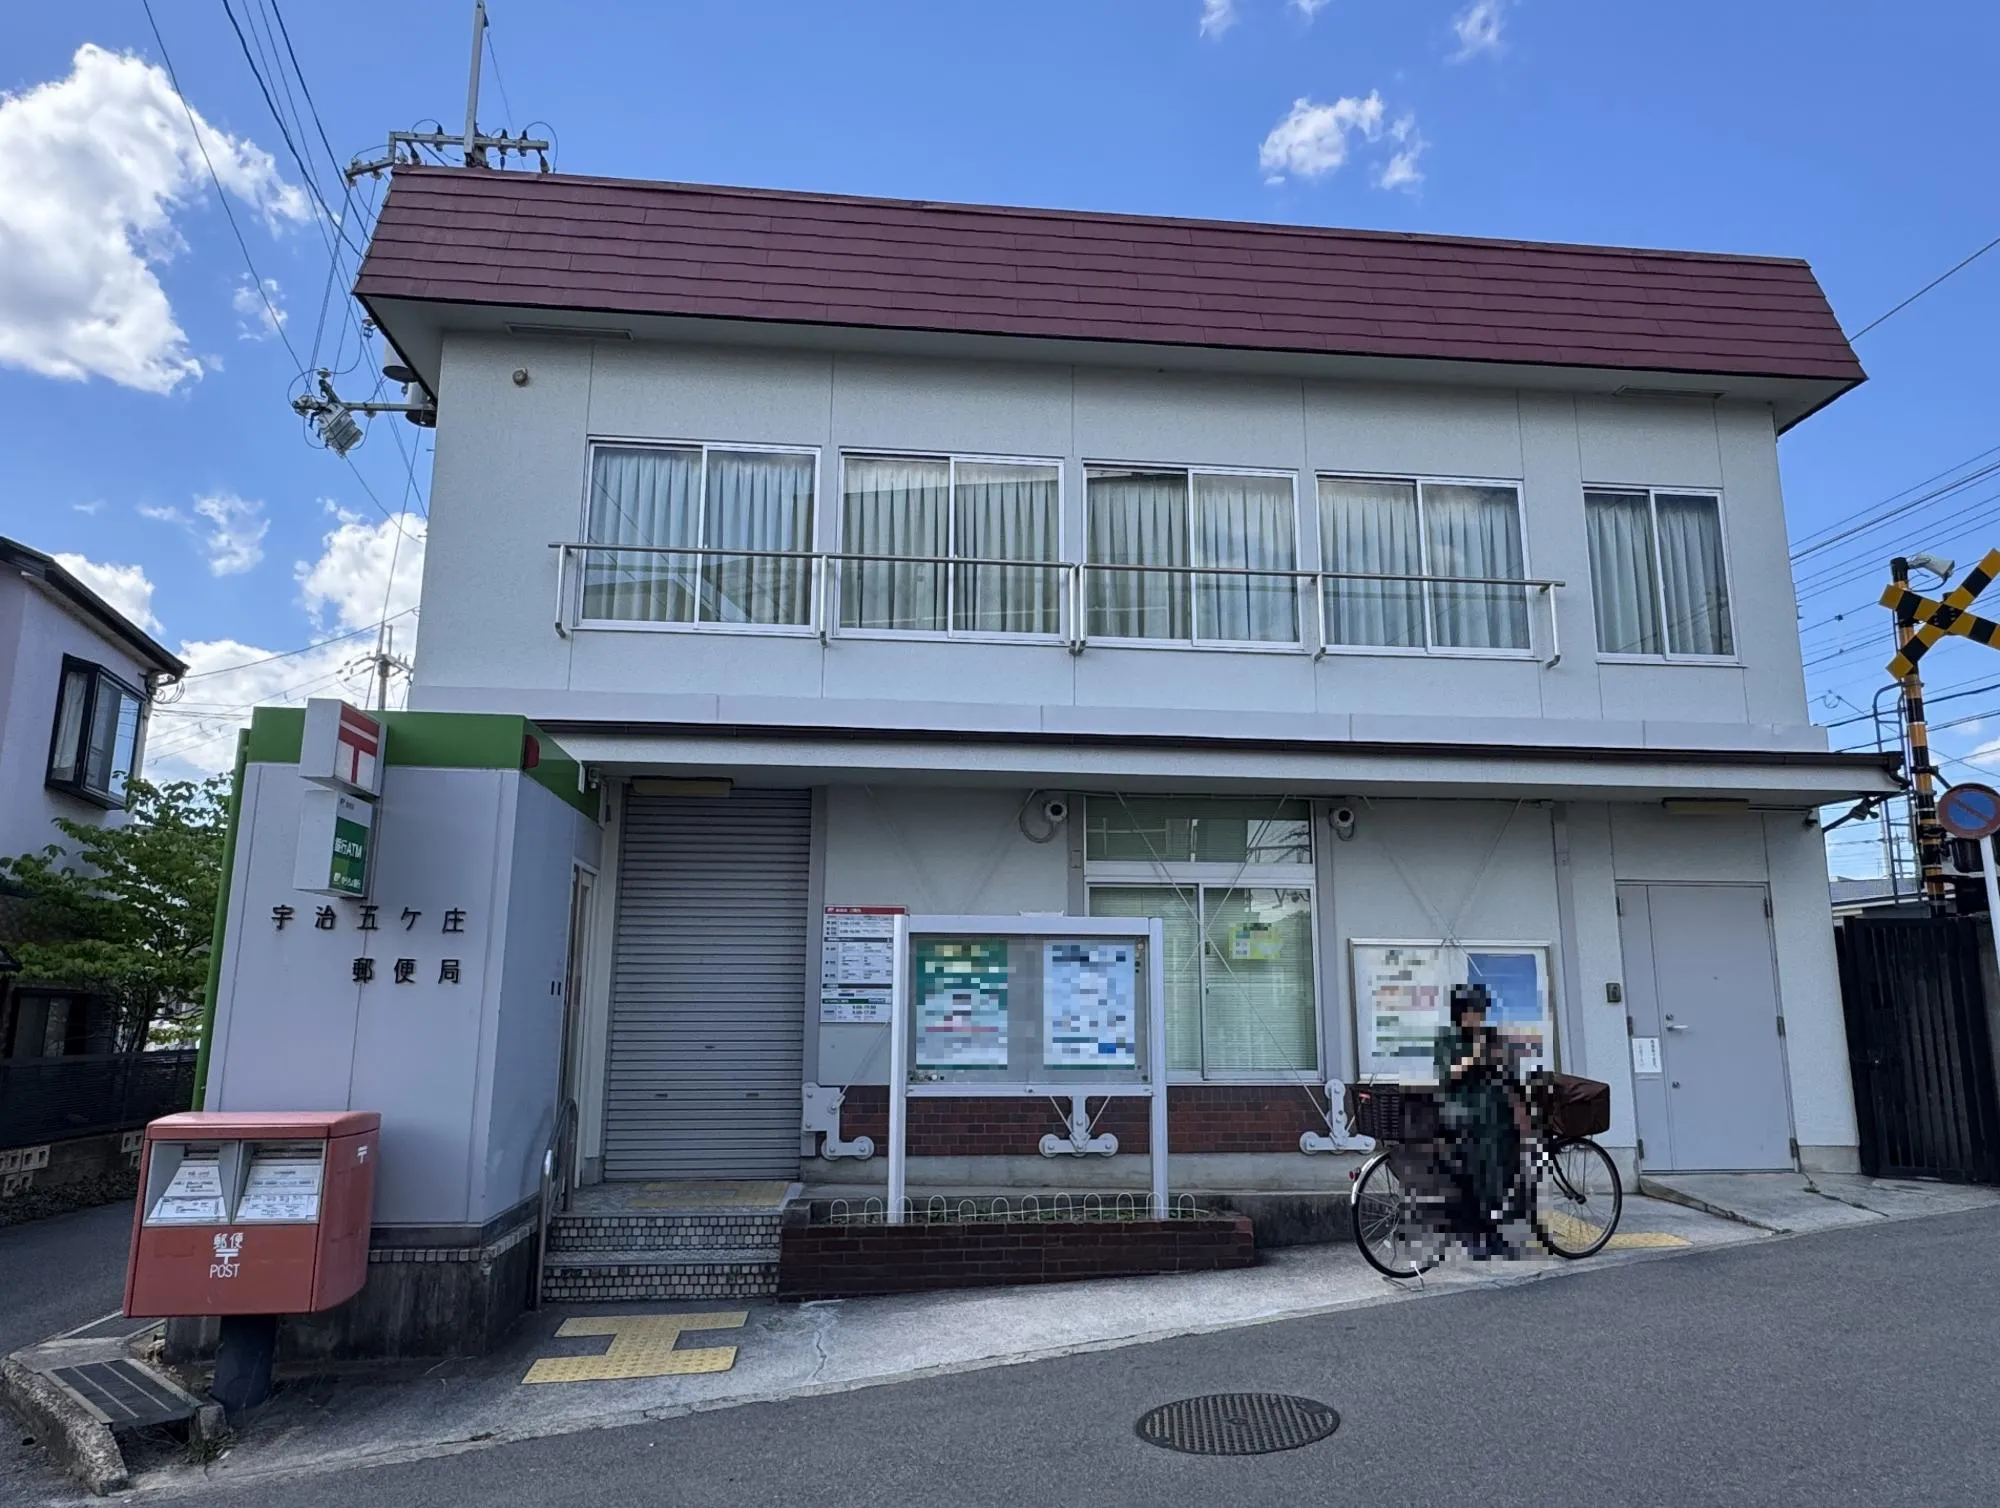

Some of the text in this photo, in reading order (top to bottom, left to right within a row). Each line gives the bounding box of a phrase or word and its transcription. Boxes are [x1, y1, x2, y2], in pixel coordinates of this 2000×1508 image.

[352, 957, 462, 985] 郵便局
[213, 1232, 245, 1250] 郵便
[209, 1263, 241, 1279] POST
